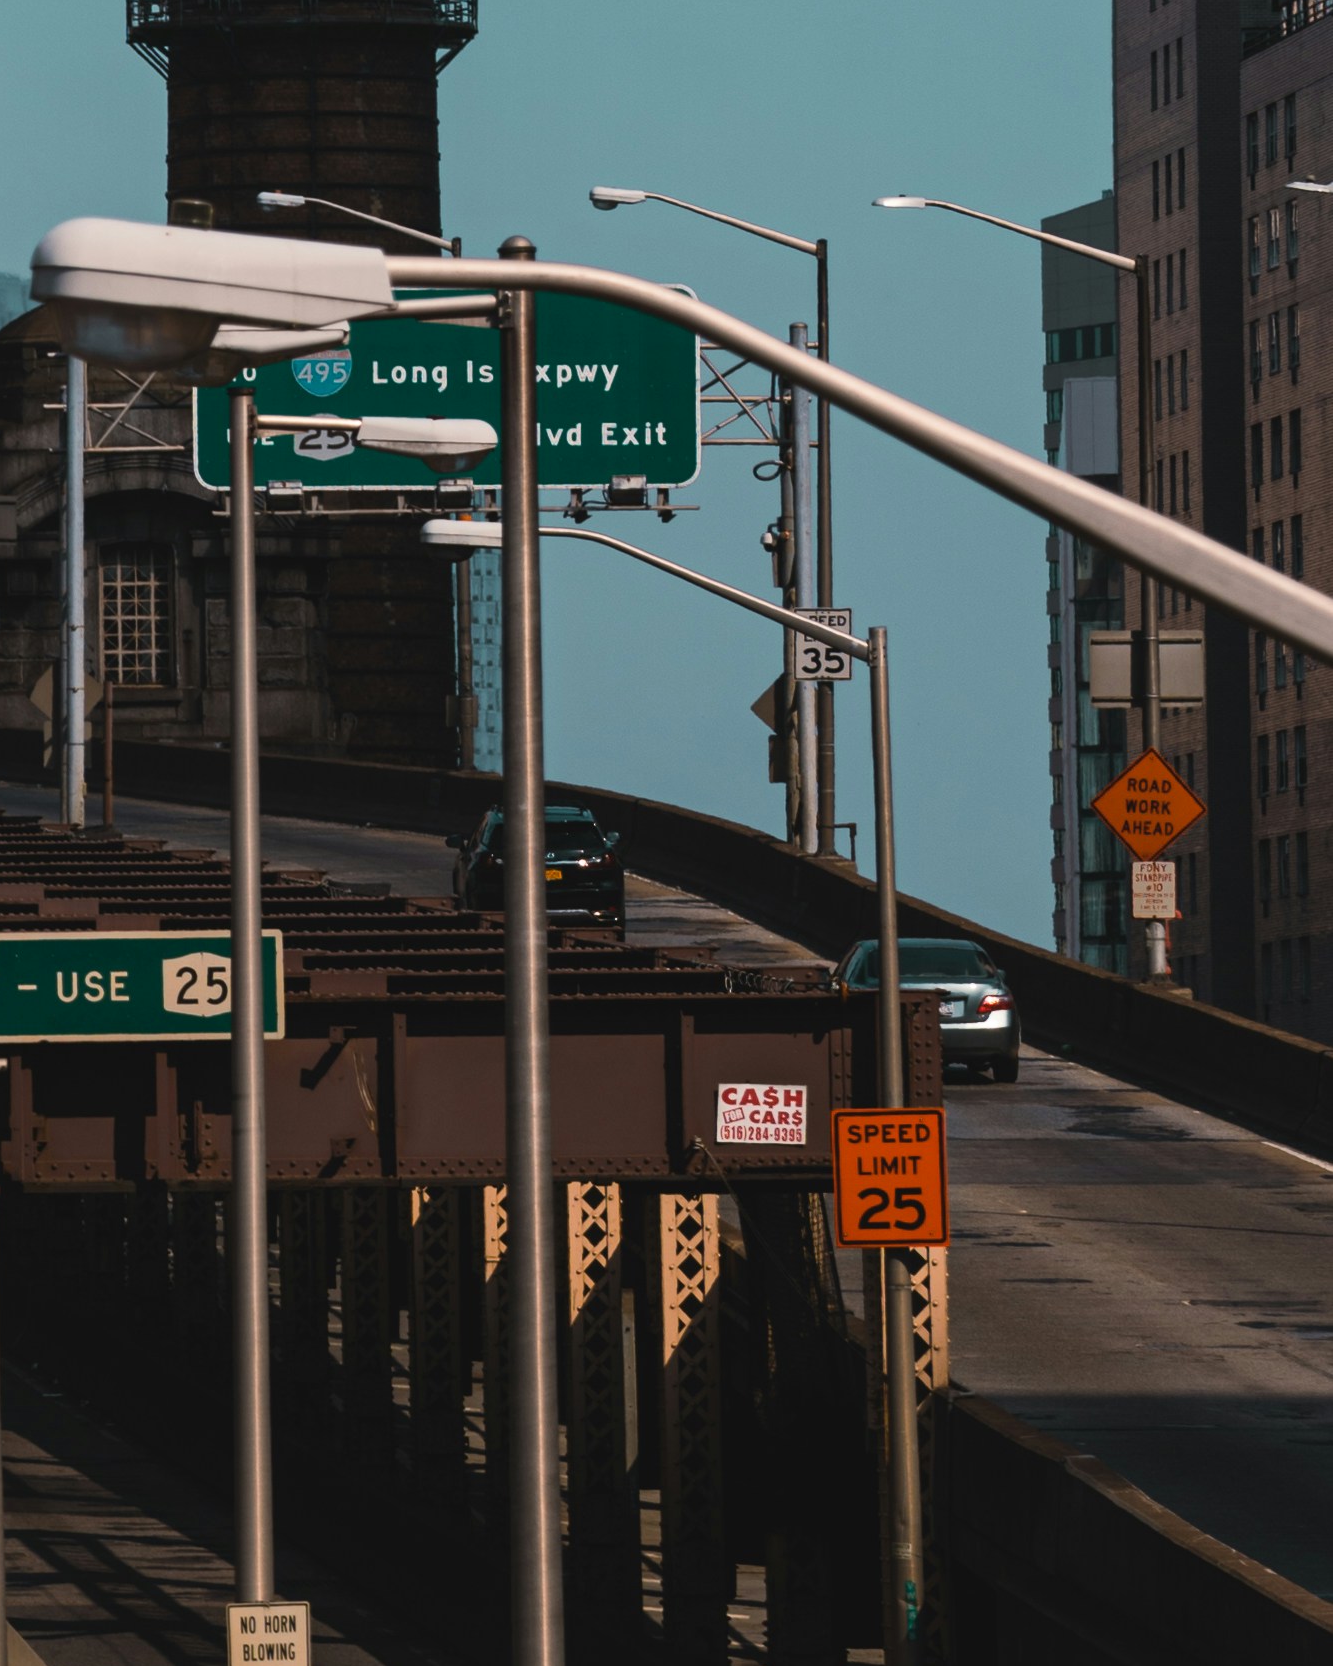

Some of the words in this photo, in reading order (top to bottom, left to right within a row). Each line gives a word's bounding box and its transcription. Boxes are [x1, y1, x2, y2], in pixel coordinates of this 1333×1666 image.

[297, 362, 348, 384] 495
[372, 360, 448, 392] Long
[466, 360, 494, 384] Is
[535, 360, 619, 391] xpwy
[537, 422, 583, 446] lvd
[601, 422, 668, 446] Exit
[802, 647, 845, 674] 35
[1127, 777, 1172, 794] ROAD
[1125, 798, 1171, 815] WORK
[1121, 819, 1175, 837] AHEAD
[56, 972, 131, 1003] USE
[175, 966, 228, 1006] 25
[721, 1086, 804, 1109] CA$H
[723, 1108, 745, 1124] FOR
[749, 1110, 803, 1126] CAR$
[847, 1124, 931, 1144] SPEED
[857, 1156, 923, 1176] LIMIT
[858, 1187, 927, 1230] 25
[240, 1616, 256, 1634] NO
[264, 1615, 297, 1634] HORN
[243, 1643, 296, 1662] BLOWING
